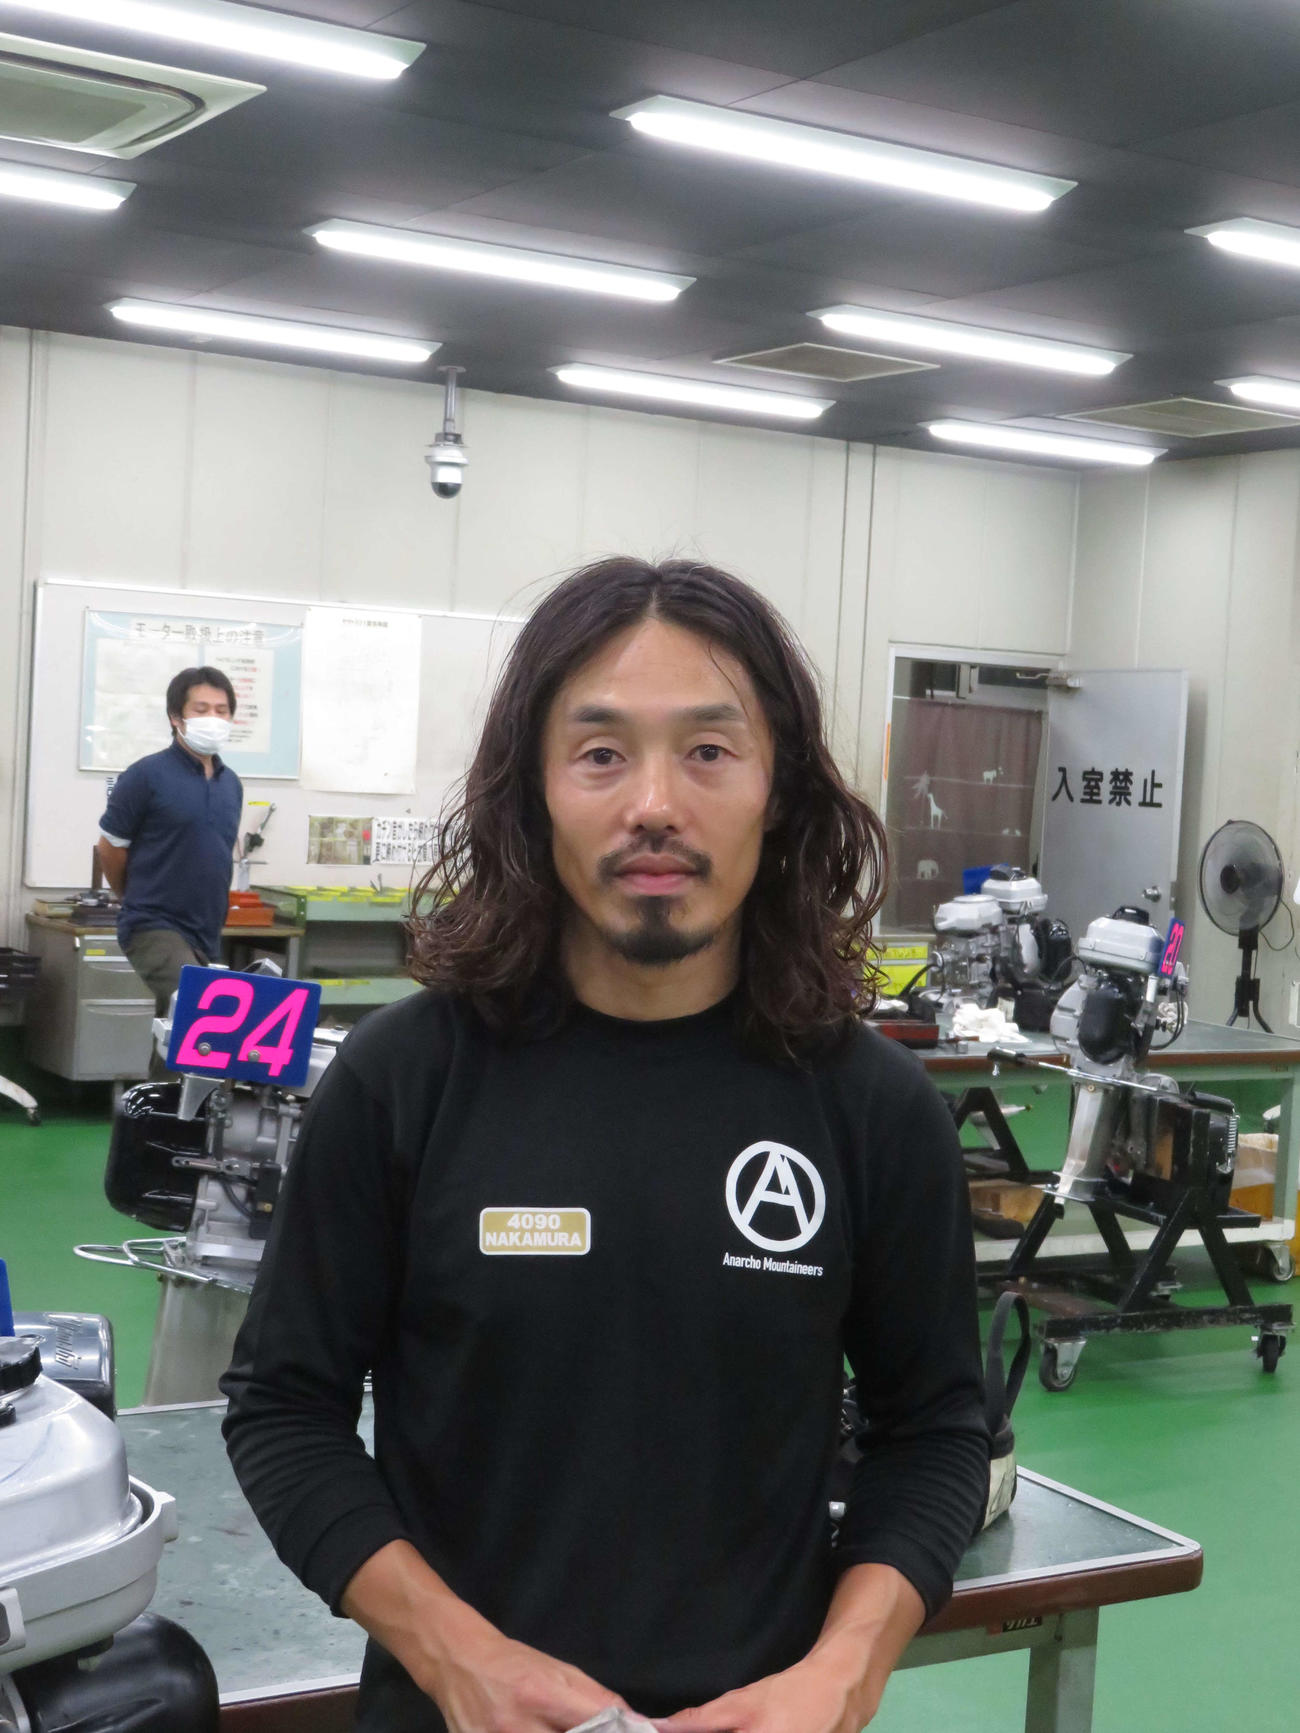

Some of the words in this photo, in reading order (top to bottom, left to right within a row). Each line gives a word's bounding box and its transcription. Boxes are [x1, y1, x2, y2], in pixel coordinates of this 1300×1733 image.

[1051, 766, 1163, 808] 入室禁止
[175, 978, 310, 1077] 24
[507, 1213, 561, 1230] 4090
[485, 1231, 582, 1247] NAKAMURA
[722, 1252, 762, 1271] Anarcho
[763, 1256, 824, 1277] Mountaineers
